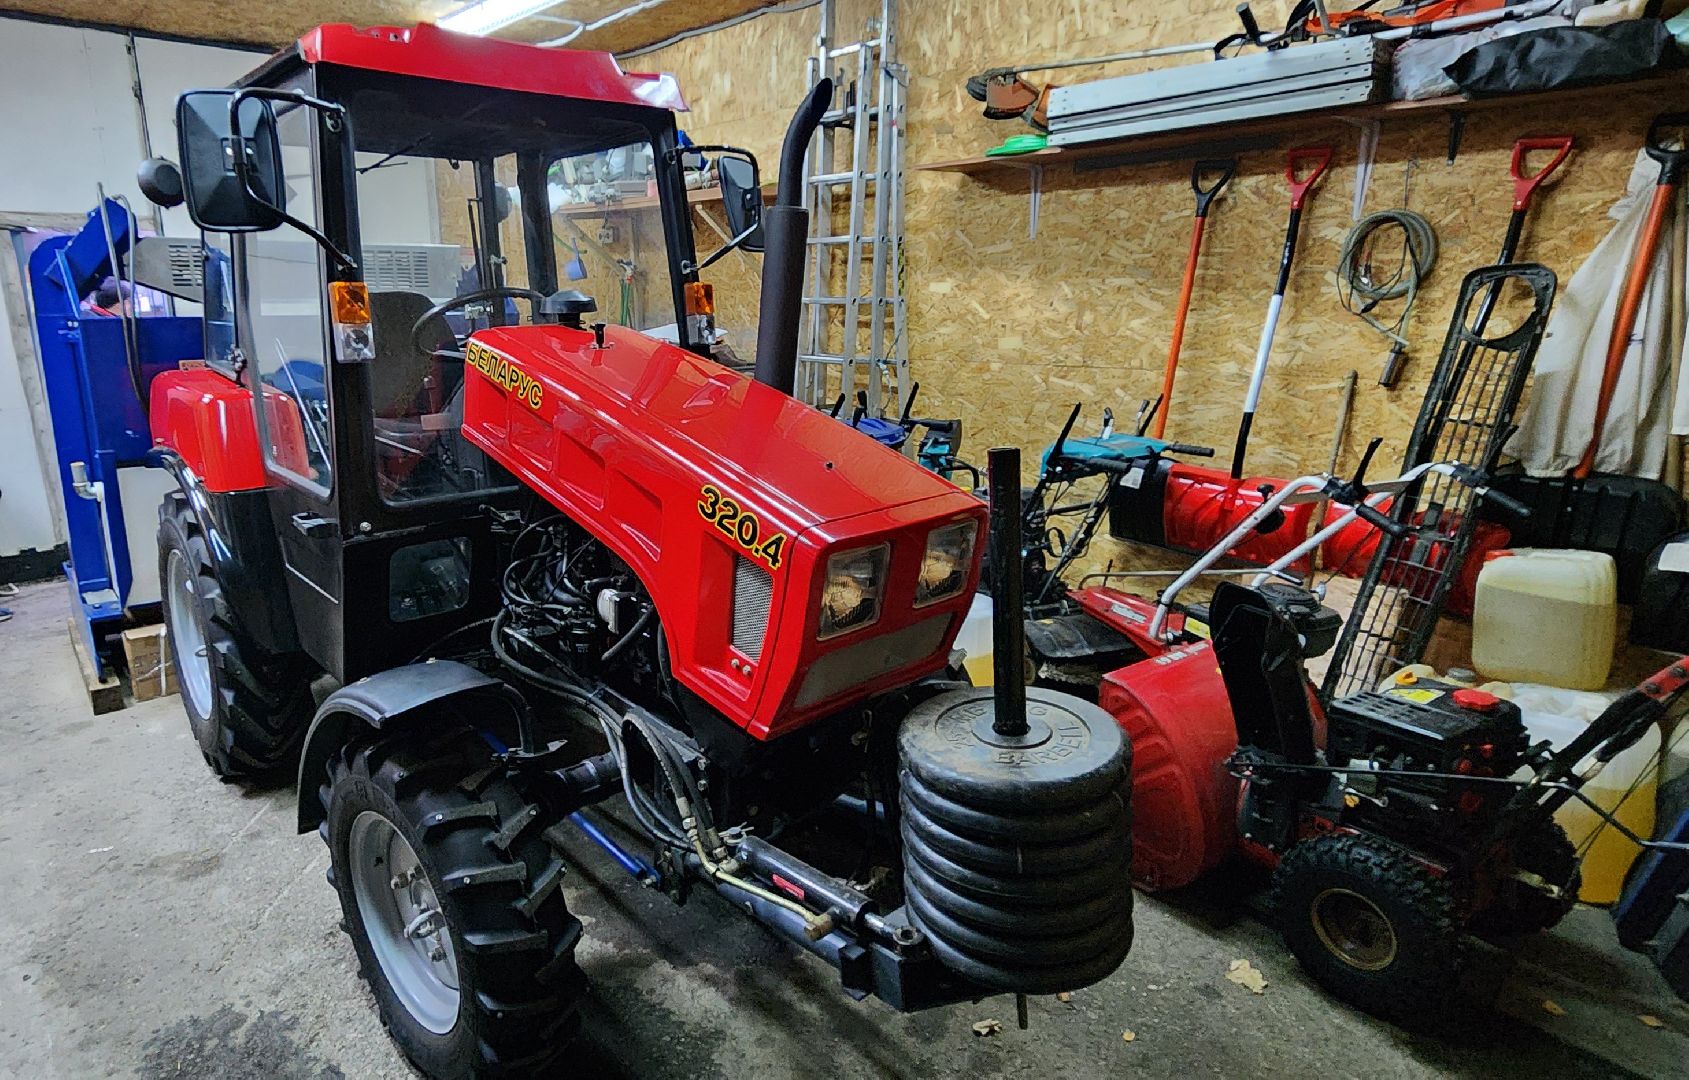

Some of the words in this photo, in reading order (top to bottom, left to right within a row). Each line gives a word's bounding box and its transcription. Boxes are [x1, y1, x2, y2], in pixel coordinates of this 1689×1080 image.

[466, 342, 543, 410] БЕЛАРУС
[697, 484, 788, 571] 320.4
[994, 721, 1084, 766] BARBELL
